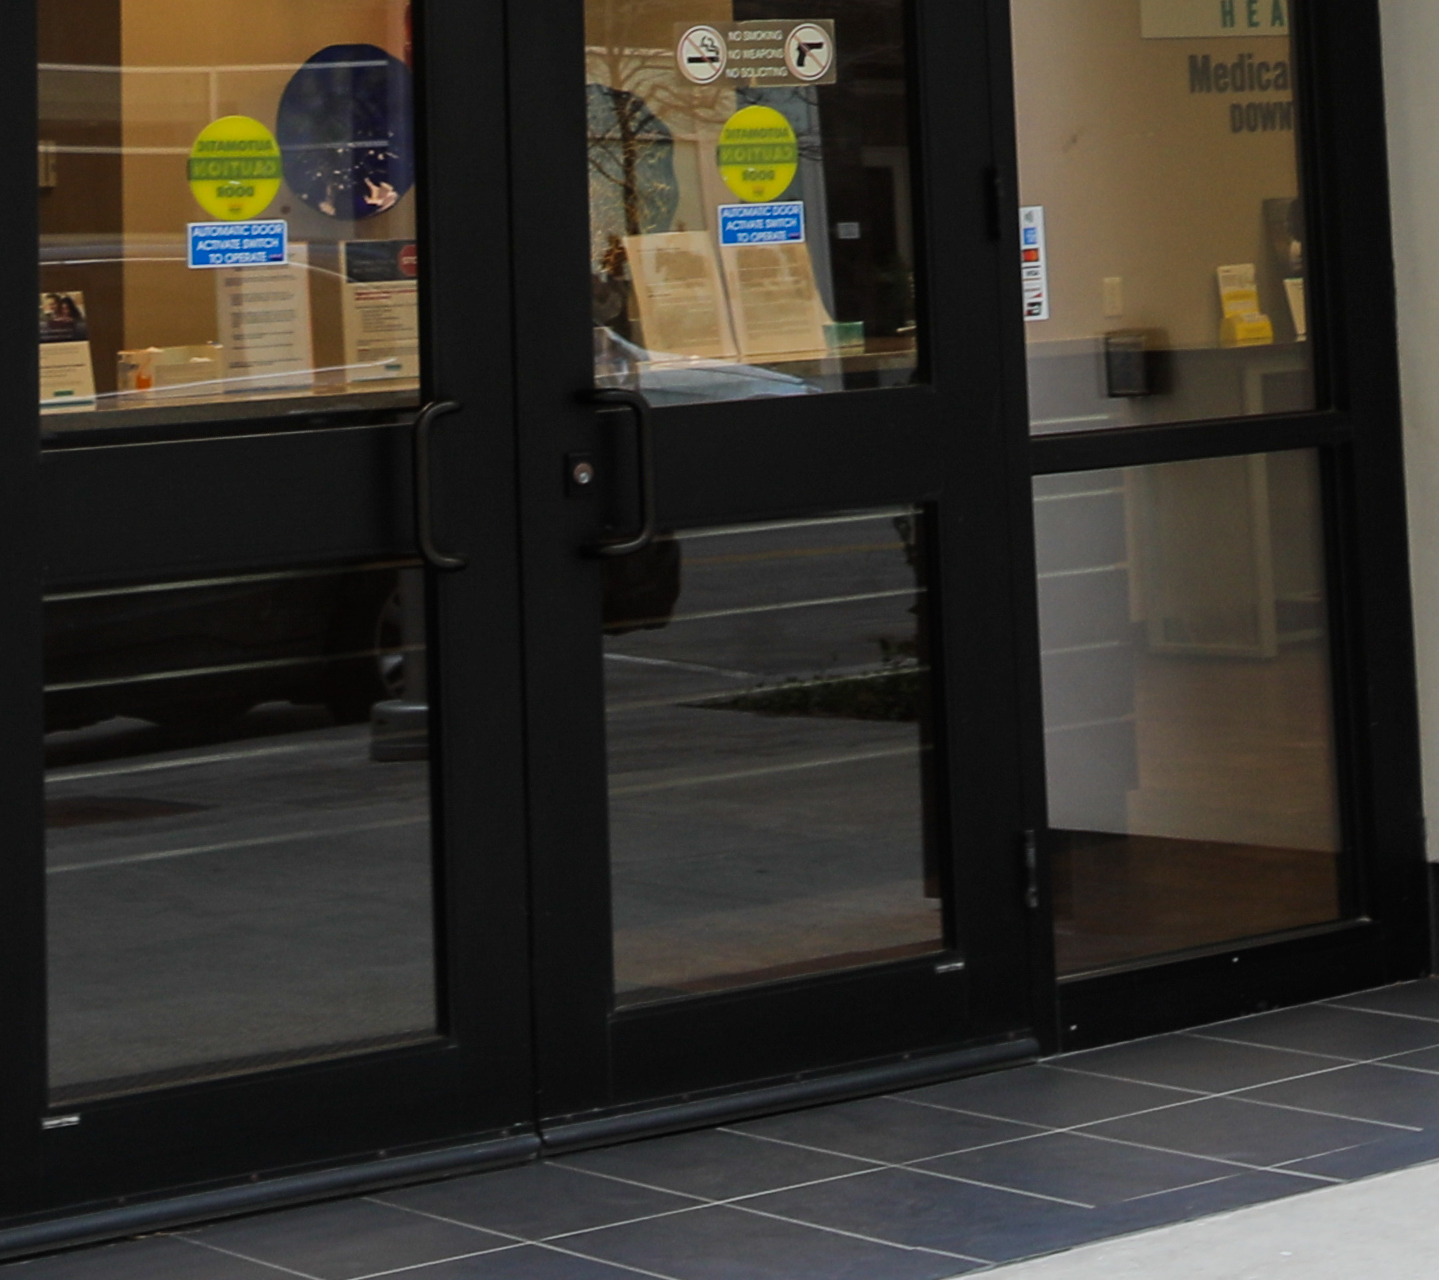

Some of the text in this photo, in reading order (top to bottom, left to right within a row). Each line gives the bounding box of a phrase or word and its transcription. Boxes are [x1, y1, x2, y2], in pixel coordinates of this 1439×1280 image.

[728, 29, 783, 41] NO SMOKING
[728, 48, 784, 60] NO WEAPONS
[725, 67, 788, 78] NO SOLICITING
[722, 205, 799, 218] AUTOMATIC DOOR
[725, 217, 797, 231] ACTIVATE SWITCH
[193, 225, 283, 237] AUTOMATIC DOOR
[736, 232, 749, 243] TO
[750, 231, 787, 242] OPERATE
[197, 238, 279, 251] ACTIVATE SWITCH
[208, 253, 223, 264] TO
[224, 252, 266, 263] OPERATE
